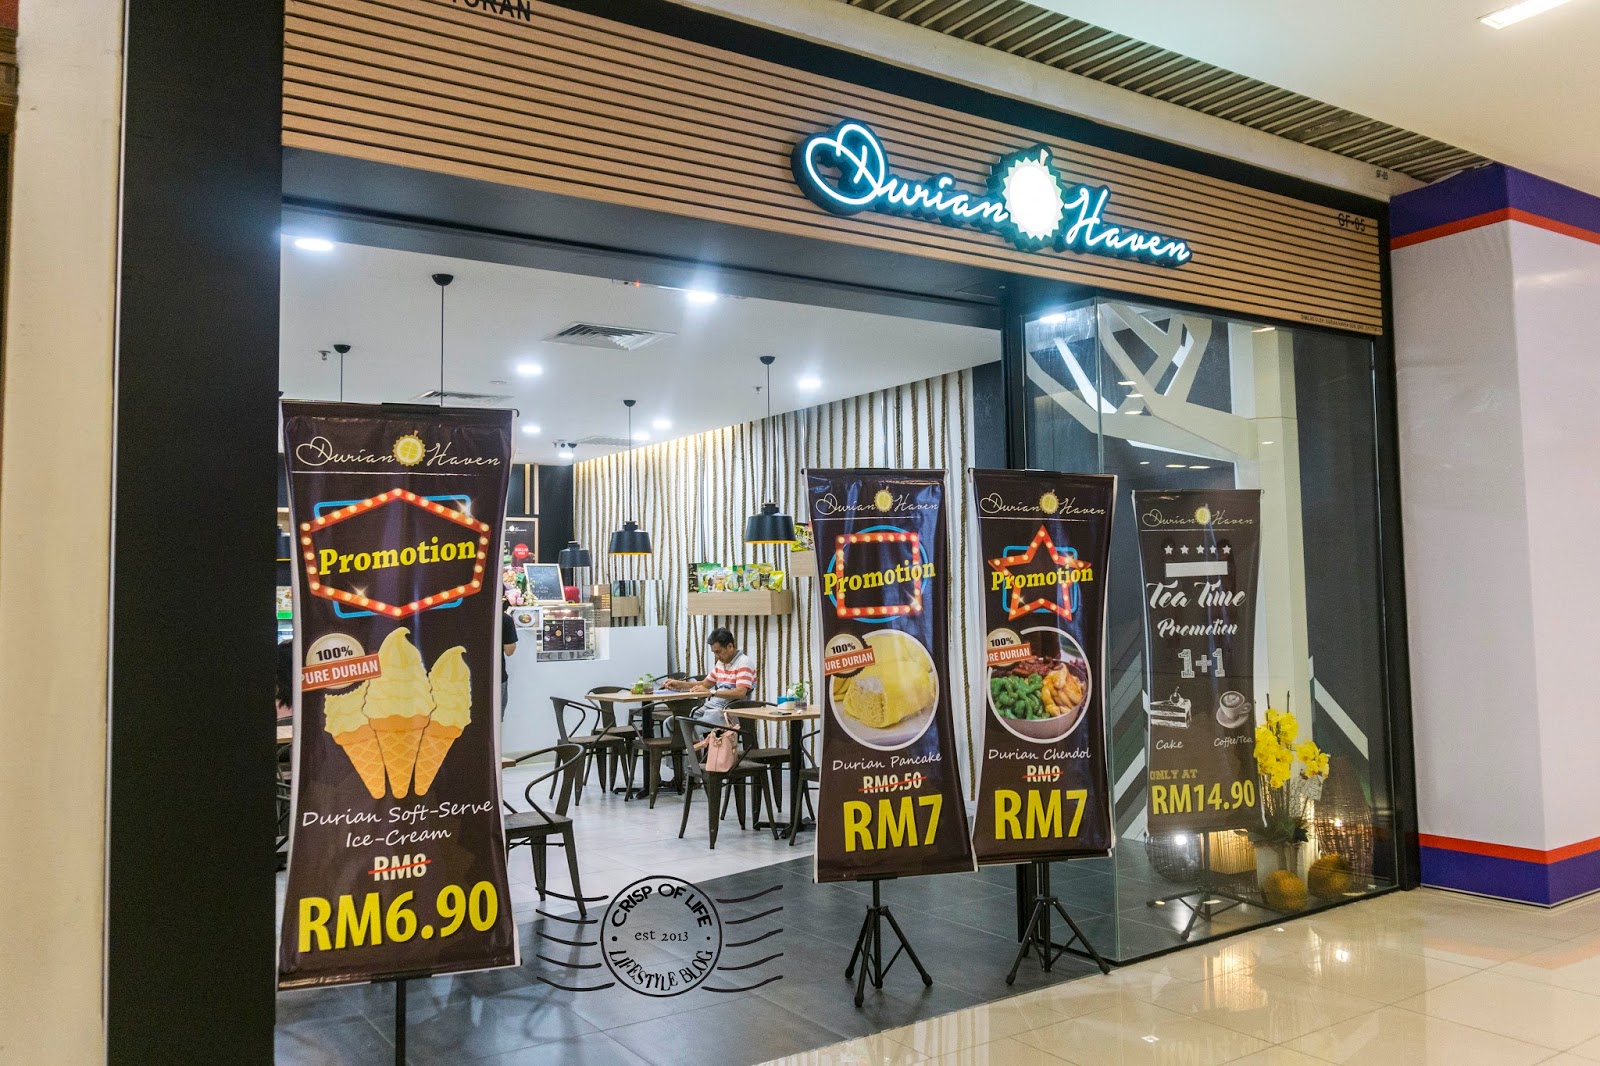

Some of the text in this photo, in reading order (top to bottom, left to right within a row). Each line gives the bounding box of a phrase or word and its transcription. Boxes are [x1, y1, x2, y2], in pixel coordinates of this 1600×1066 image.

[453, 0, 531, 21] RAN
[805, 122, 1192, 263] Durian Haven
[296, 436, 501, 466] Durian Haven
[815, 493, 939, 515] Durian Haven
[980, 492, 1106, 515] Durian Haven
[1142, 508, 1254, 527] Durian Haven
[319, 536, 477, 576] Promotion
[823, 560, 936, 596] Promotion
[991, 564, 1094, 591] Promotion
[1146, 579, 1247, 609] Tea Time
[1157, 618, 1239, 638] Promotion
[831, 642, 856, 654] 100%
[990, 637, 1014, 647] 100%
[316, 645, 354, 661] 100%
[825, 652, 874, 671] URE DURIAN
[988, 647, 1030, 662] RE DURIAN
[1178, 647, 1226, 679] 1+1
[332, 660, 379, 680] DURIAN
[1155, 739, 1184, 750] Cake
[1213, 735, 1254, 748] Coffee/Tea
[832, 752, 942, 771] Durian Pancake
[988, 747, 1091, 760] Durian Chendol
[863, 772, 922, 794] RM9.50
[1026, 764, 1061, 783] RM9
[1149, 768, 1198, 780] ONLY AT
[1151, 779, 1256, 815] RM14.90
[302, 800, 494, 827] Durian Soft-Serve
[843, 794, 942, 852] RM7
[994, 789, 1088, 840] RM7
[346, 828, 452, 848] Ice-Cream
[373, 853, 428, 882] RM8
[298, 881, 499, 953] RM6.90
